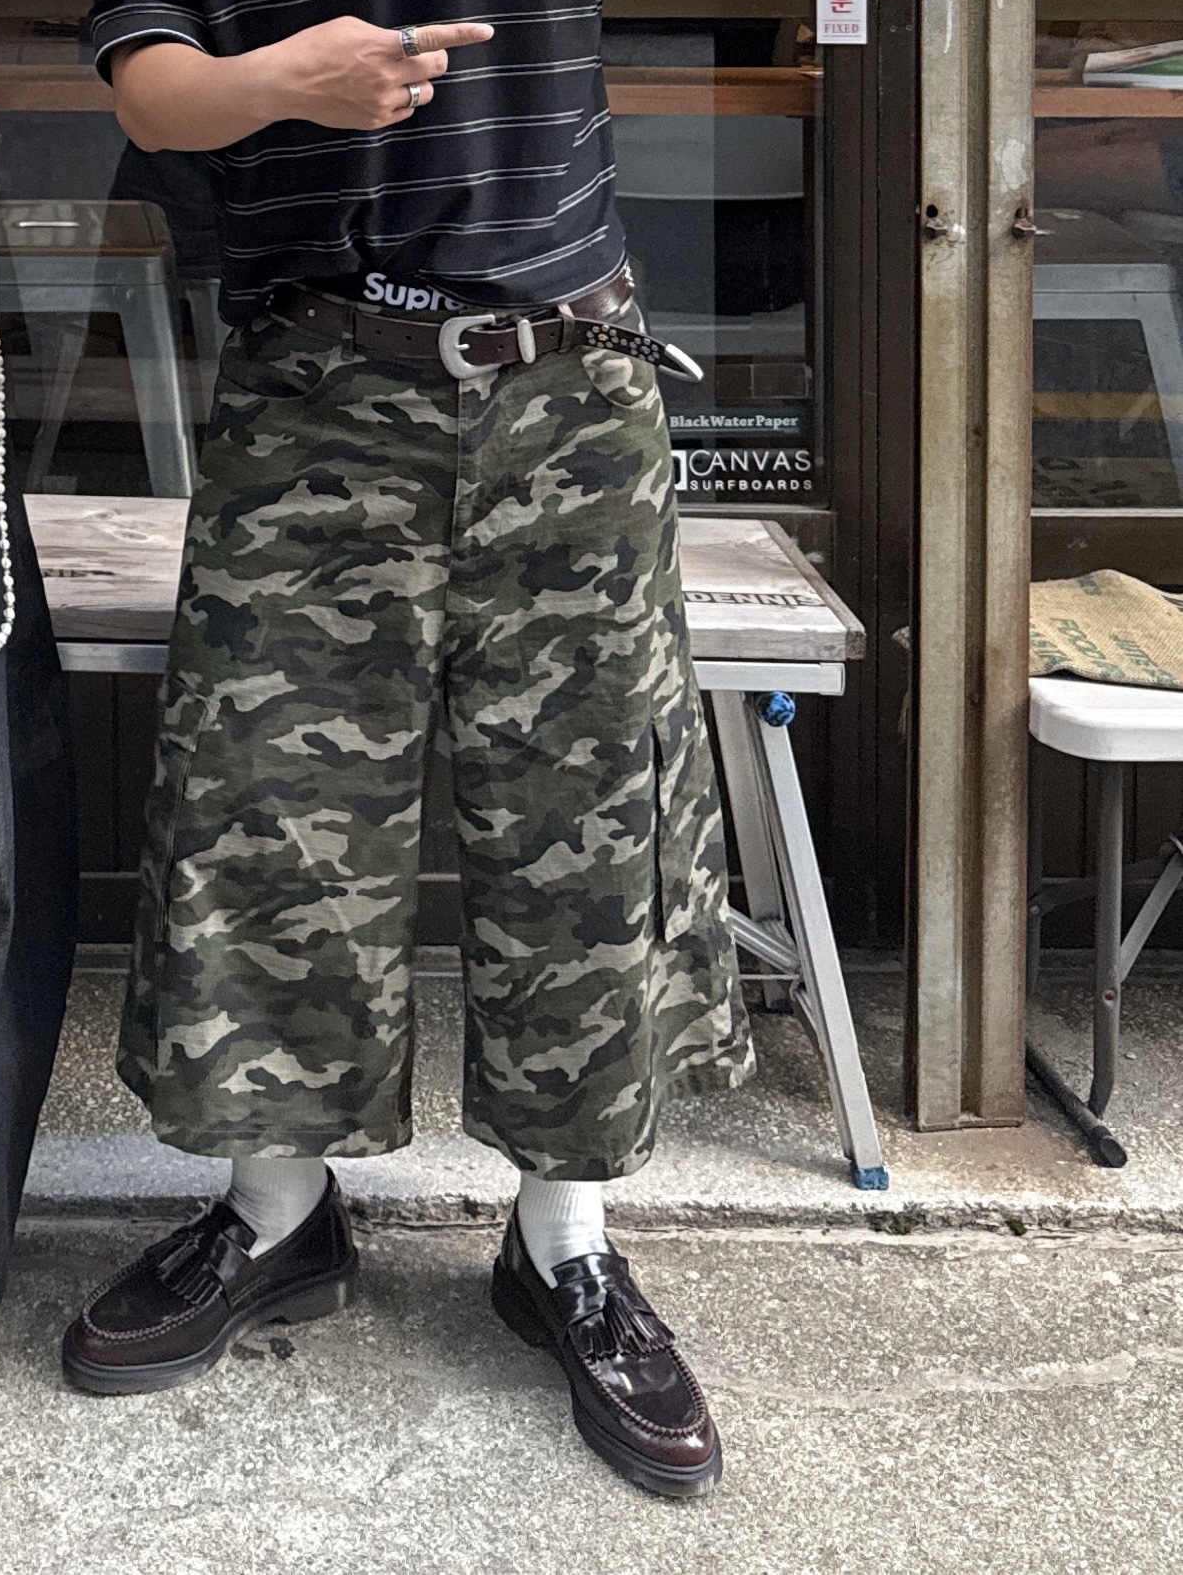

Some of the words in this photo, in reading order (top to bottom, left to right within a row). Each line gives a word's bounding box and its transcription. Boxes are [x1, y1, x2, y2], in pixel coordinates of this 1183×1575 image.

[823, 23, 859, 34] FIXED
[689, 449, 812, 476] CANVAS
[690, 479, 813, 491] SURFBOARDS
[684, 590, 825, 607] DENNIS
